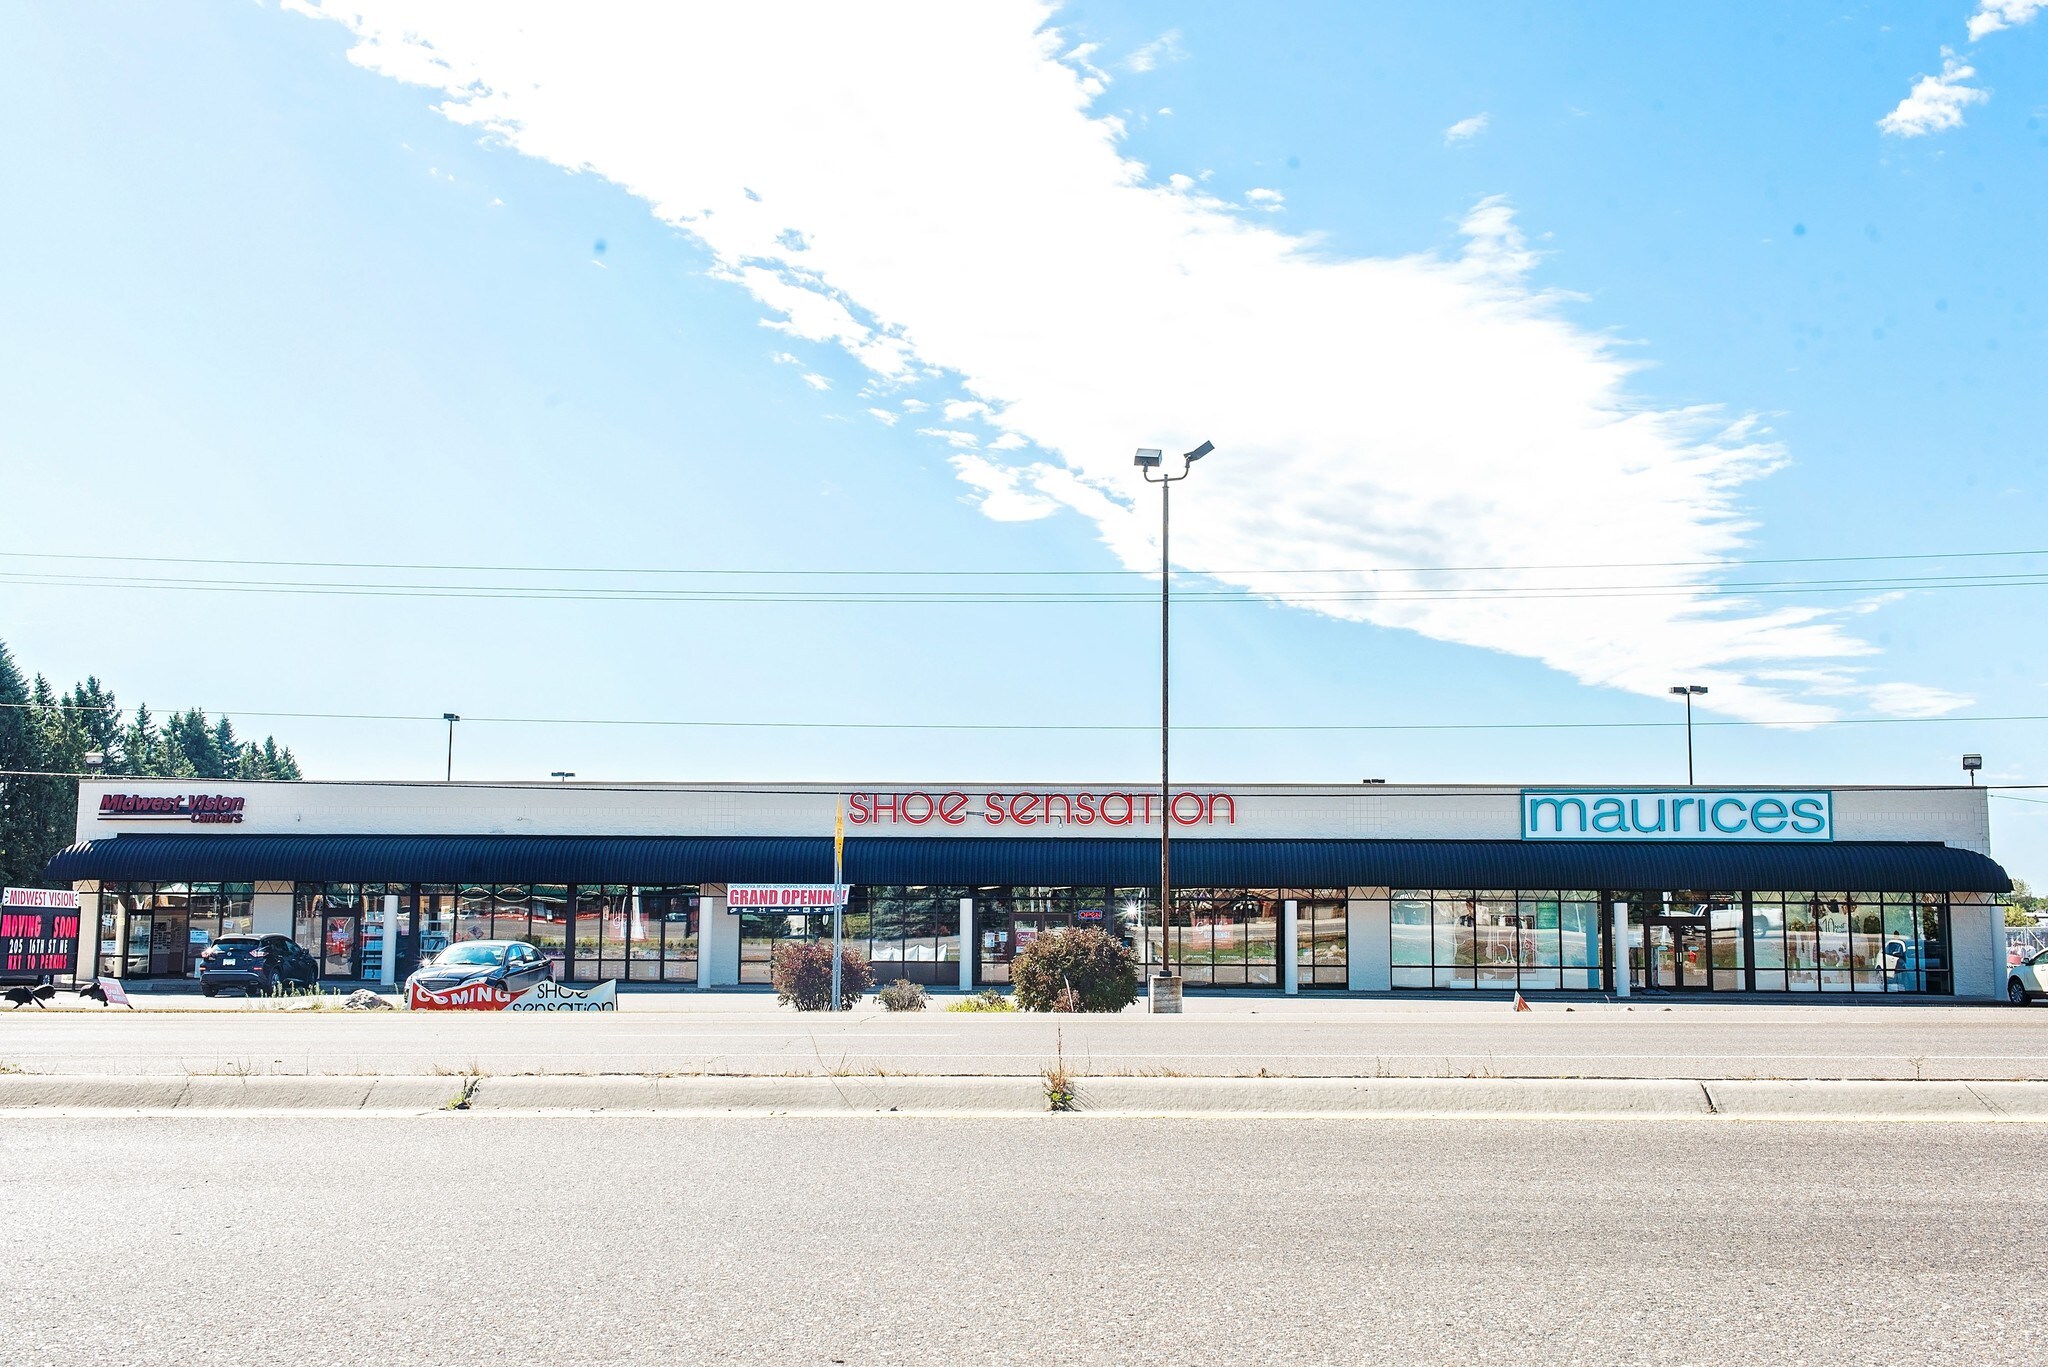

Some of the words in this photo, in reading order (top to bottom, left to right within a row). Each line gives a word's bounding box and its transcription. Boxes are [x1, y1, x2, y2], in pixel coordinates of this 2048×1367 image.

[99, 794, 185, 810] Midwest
[188, 794, 245, 810] Vision
[983, 790, 1236, 826] sensaTon
[1530, 797, 1826, 834] maurices
[9, 890, 47, 906] MIDWEST
[49, 891, 75, 907] VISION
[730, 889, 778, 905] GRAND
[1, 915, 41, 938] MOVING
[53, 916, 78, 938] SOON
[9, 939, 23, 954] 205
[29, 939, 45, 954] 16TH
[48, 939, 56, 954] ST
[59, 939, 68, 954] NE
[8, 955, 22, 970] NXT
[27, 955, 36, 970] TO
[40, 955, 67, 969] PERKINS
